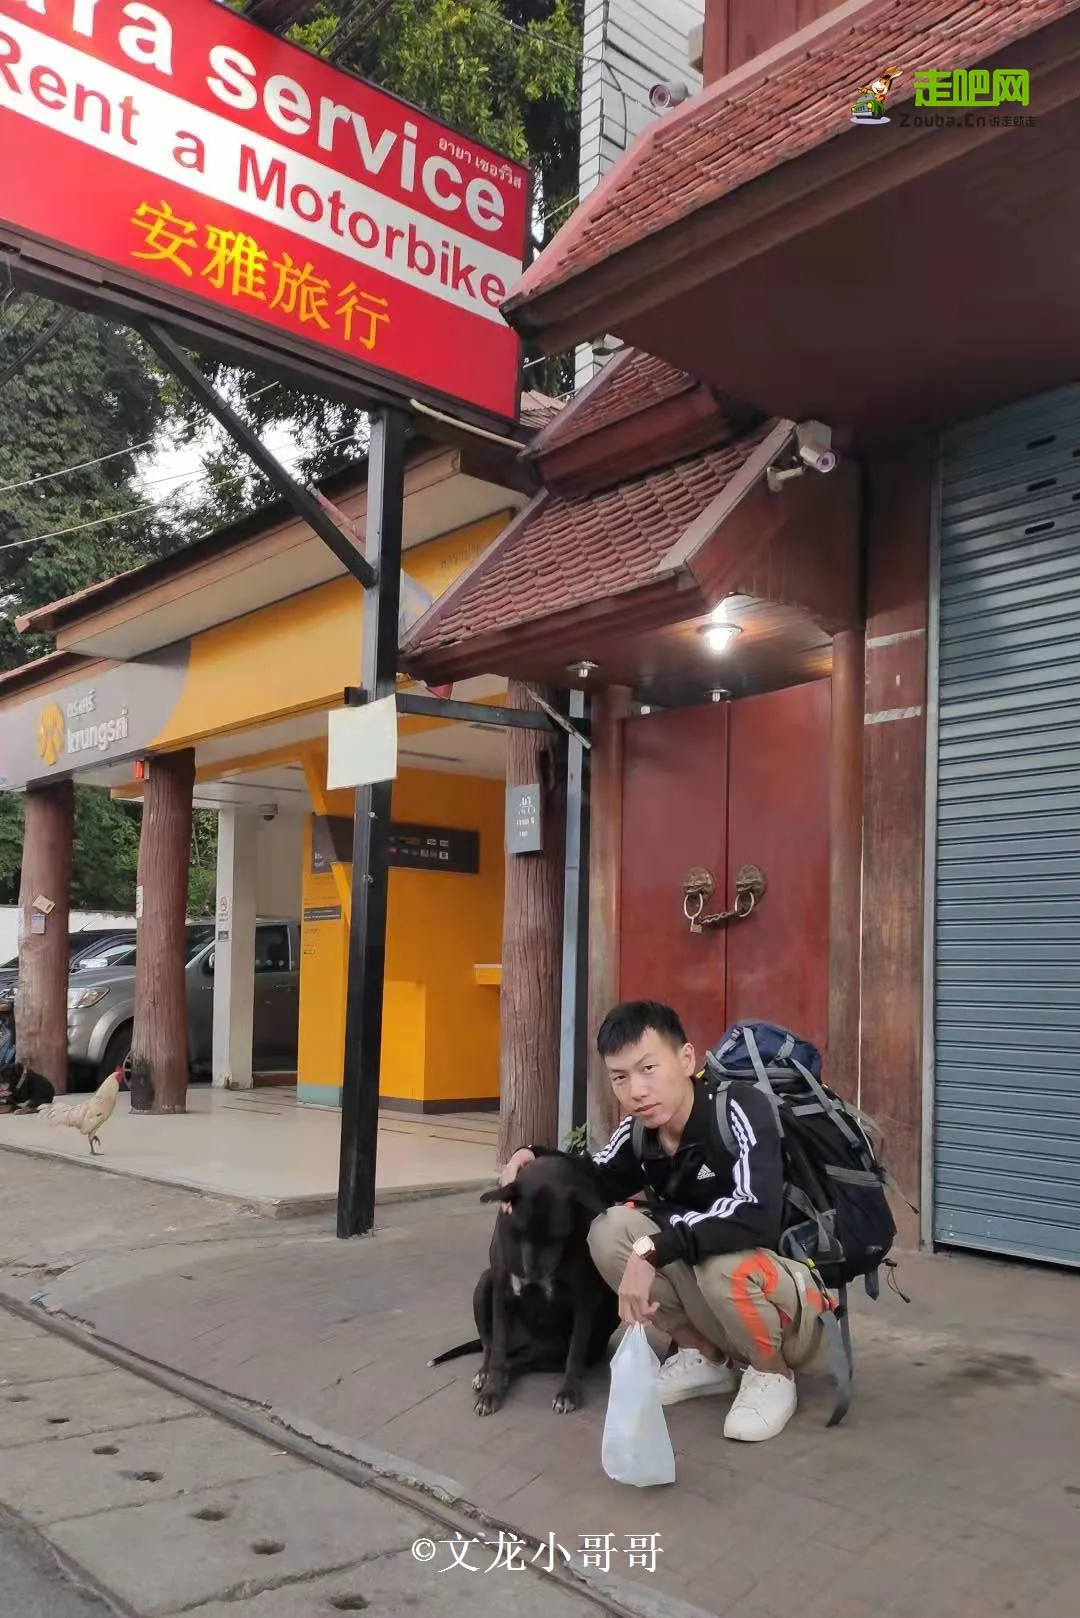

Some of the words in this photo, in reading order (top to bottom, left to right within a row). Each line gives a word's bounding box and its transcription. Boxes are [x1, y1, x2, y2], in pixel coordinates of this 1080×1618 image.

[0, 30, 140, 146] Rent
[172, 129, 206, 174] a
[238, 144, 507, 310] Motorbike
[205, 44, 506, 232] service
[130, 200, 390, 351] 安雅旅行
